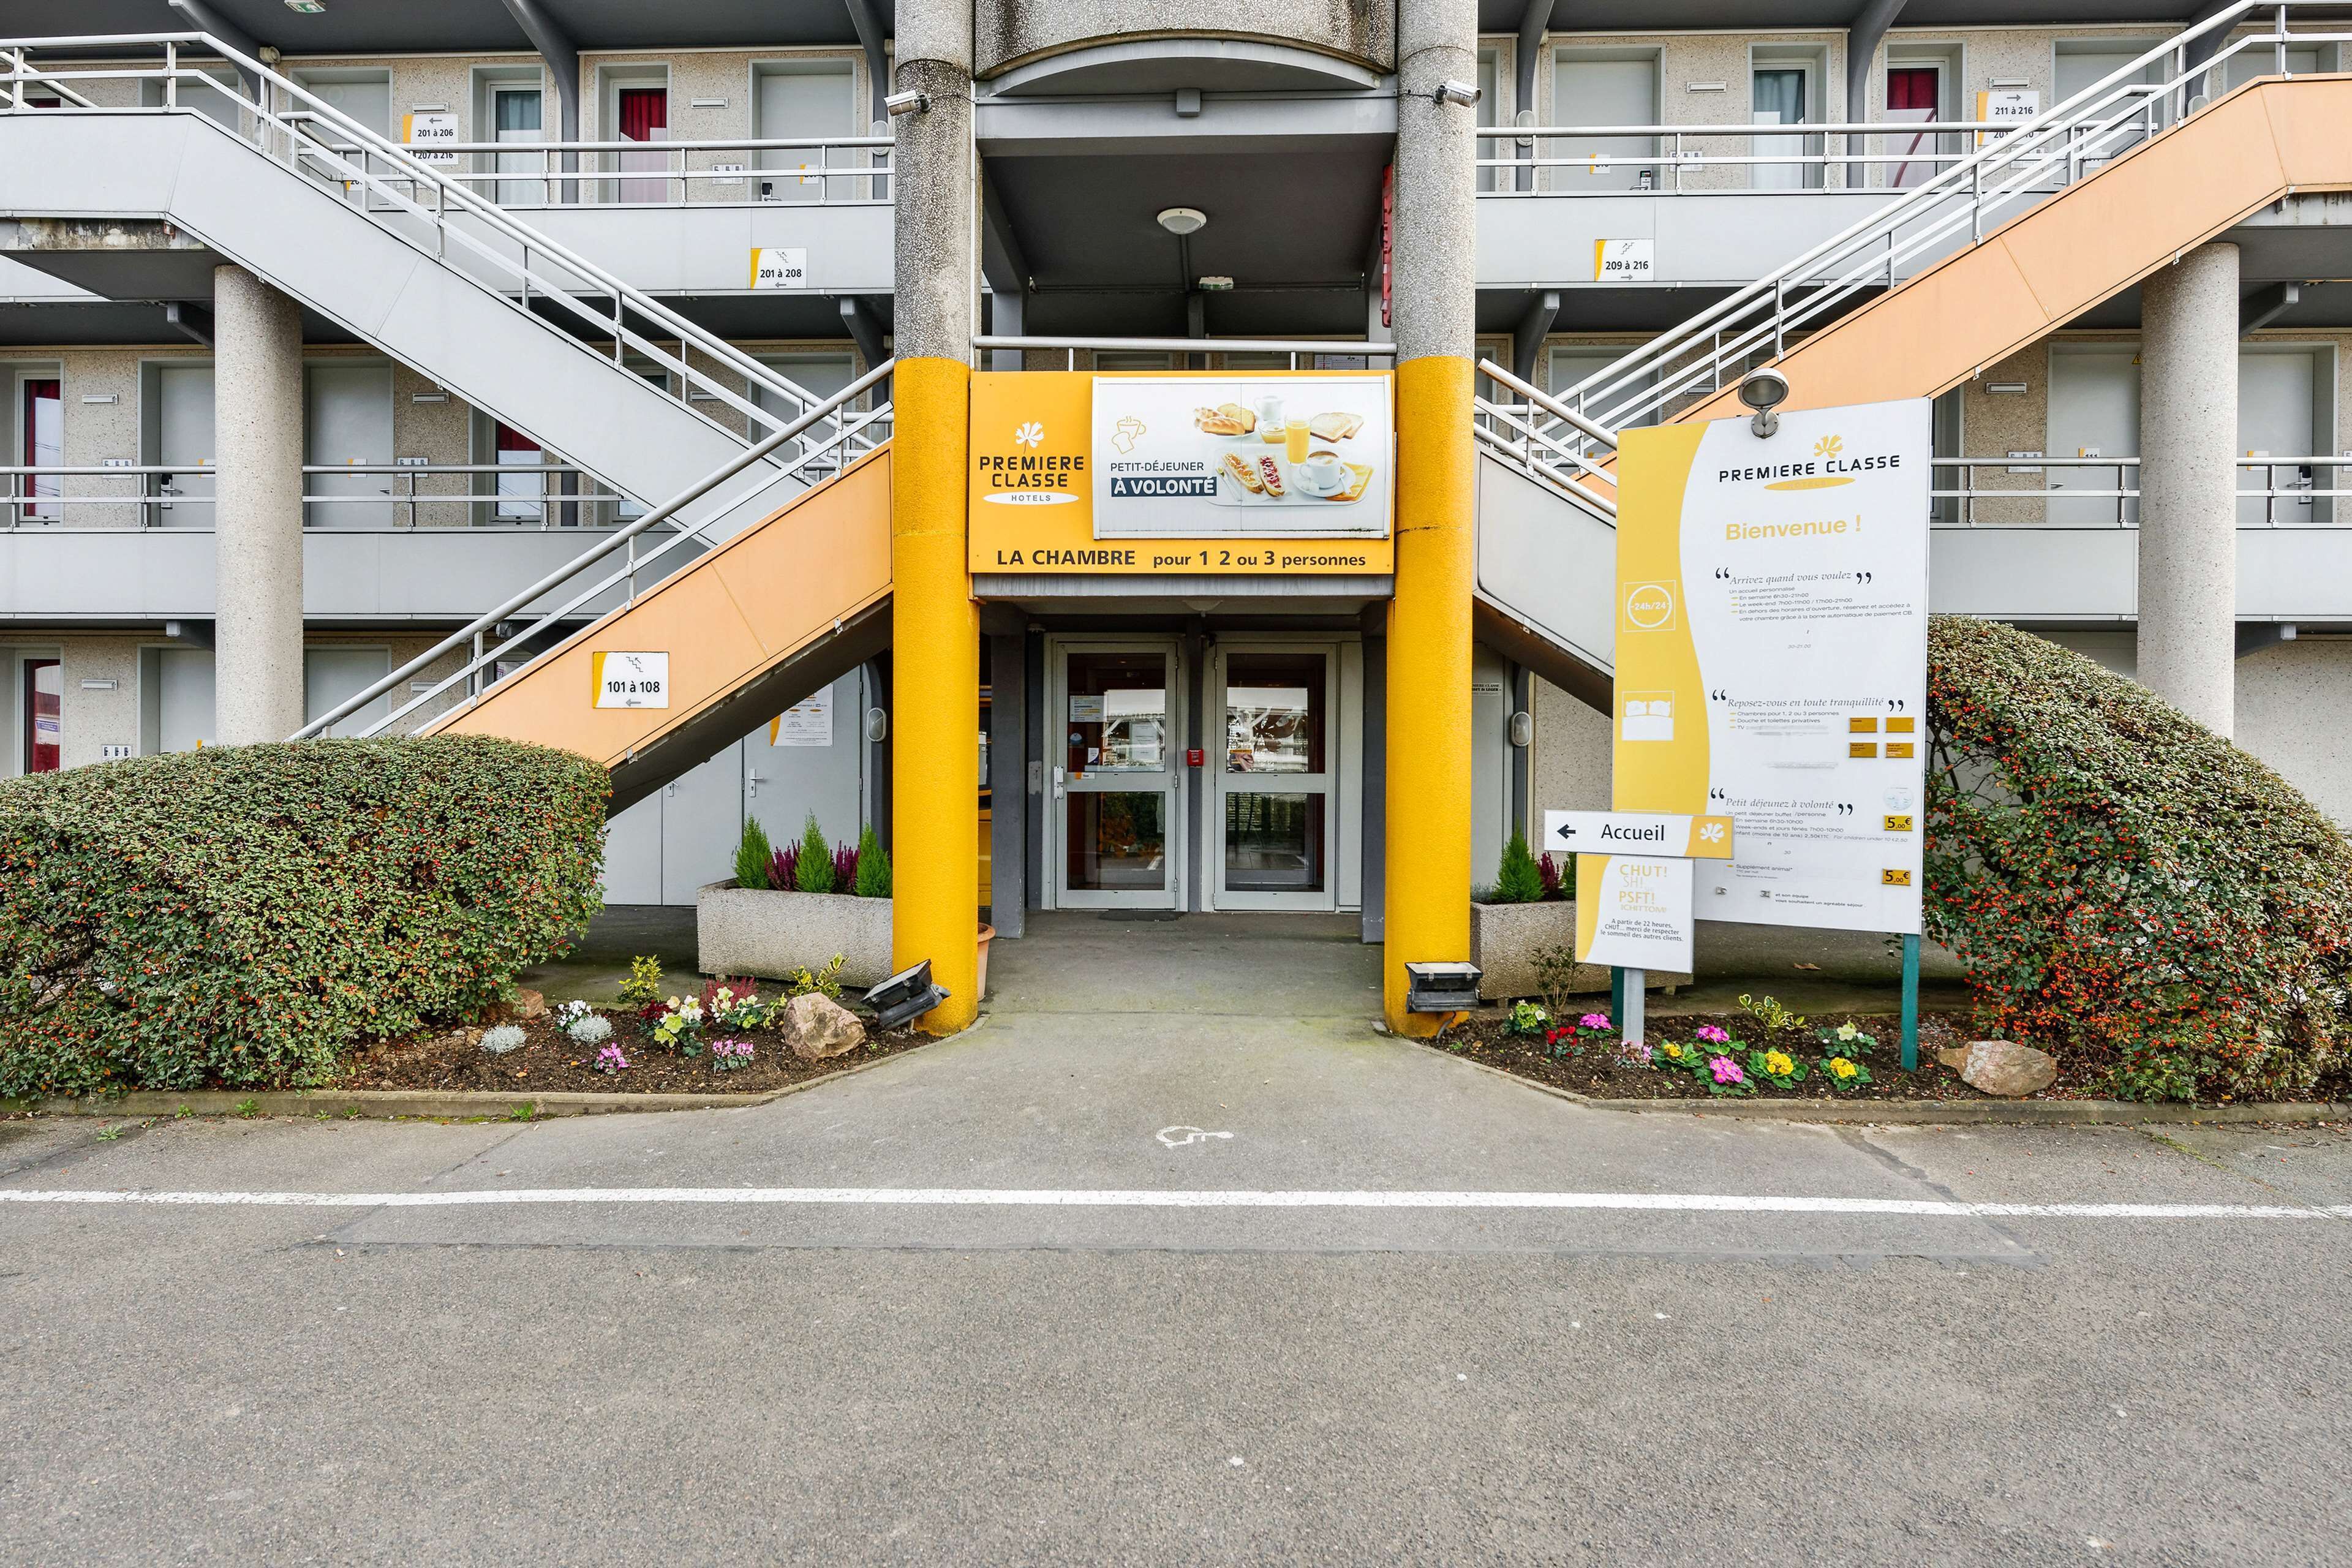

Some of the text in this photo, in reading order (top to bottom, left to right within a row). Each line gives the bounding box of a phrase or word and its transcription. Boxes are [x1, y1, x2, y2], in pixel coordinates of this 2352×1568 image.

[1996, 107, 2008, 115] 211
[1605, 261, 1649, 270] 209 à 216
[760, 270, 774, 278] 201
[778, 269, 783, 277] à
[980, 456, 1084, 470] PREMIERE
[1110, 459, 1204, 472] PETIT-DÉJEUNER
[1719, 454, 1900, 483] PREMIERE CLASSE
[992, 473, 1068, 488] CLASSE
[1114, 477, 1215, 494] À VOLONTÉ
[1726, 514, 1861, 540] Bienvenue !
[997, 550, 1366, 568] LA CHAMBRE pour 1 2 ou 3 personnes
[1730, 571, 1852, 585] Arrivez quand vous voulez
[1634, 601, 1666, 611] 24h/24
[608, 680, 660, 693] 101 à 108
[1727, 699, 1787, 709] Reposez-vous
[1803, 698, 1827, 707] toute
[1830, 697, 1884, 708] tranquillité
[1726, 797, 1747, 807] Petit
[1749, 799, 1790, 809] déjeunez
[1800, 800, 1834, 809] volonté
[1600, 823, 1665, 842] Accueil
[1619, 864, 1667, 877] CHUT!
[1619, 891, 1655, 904] PSFT!
